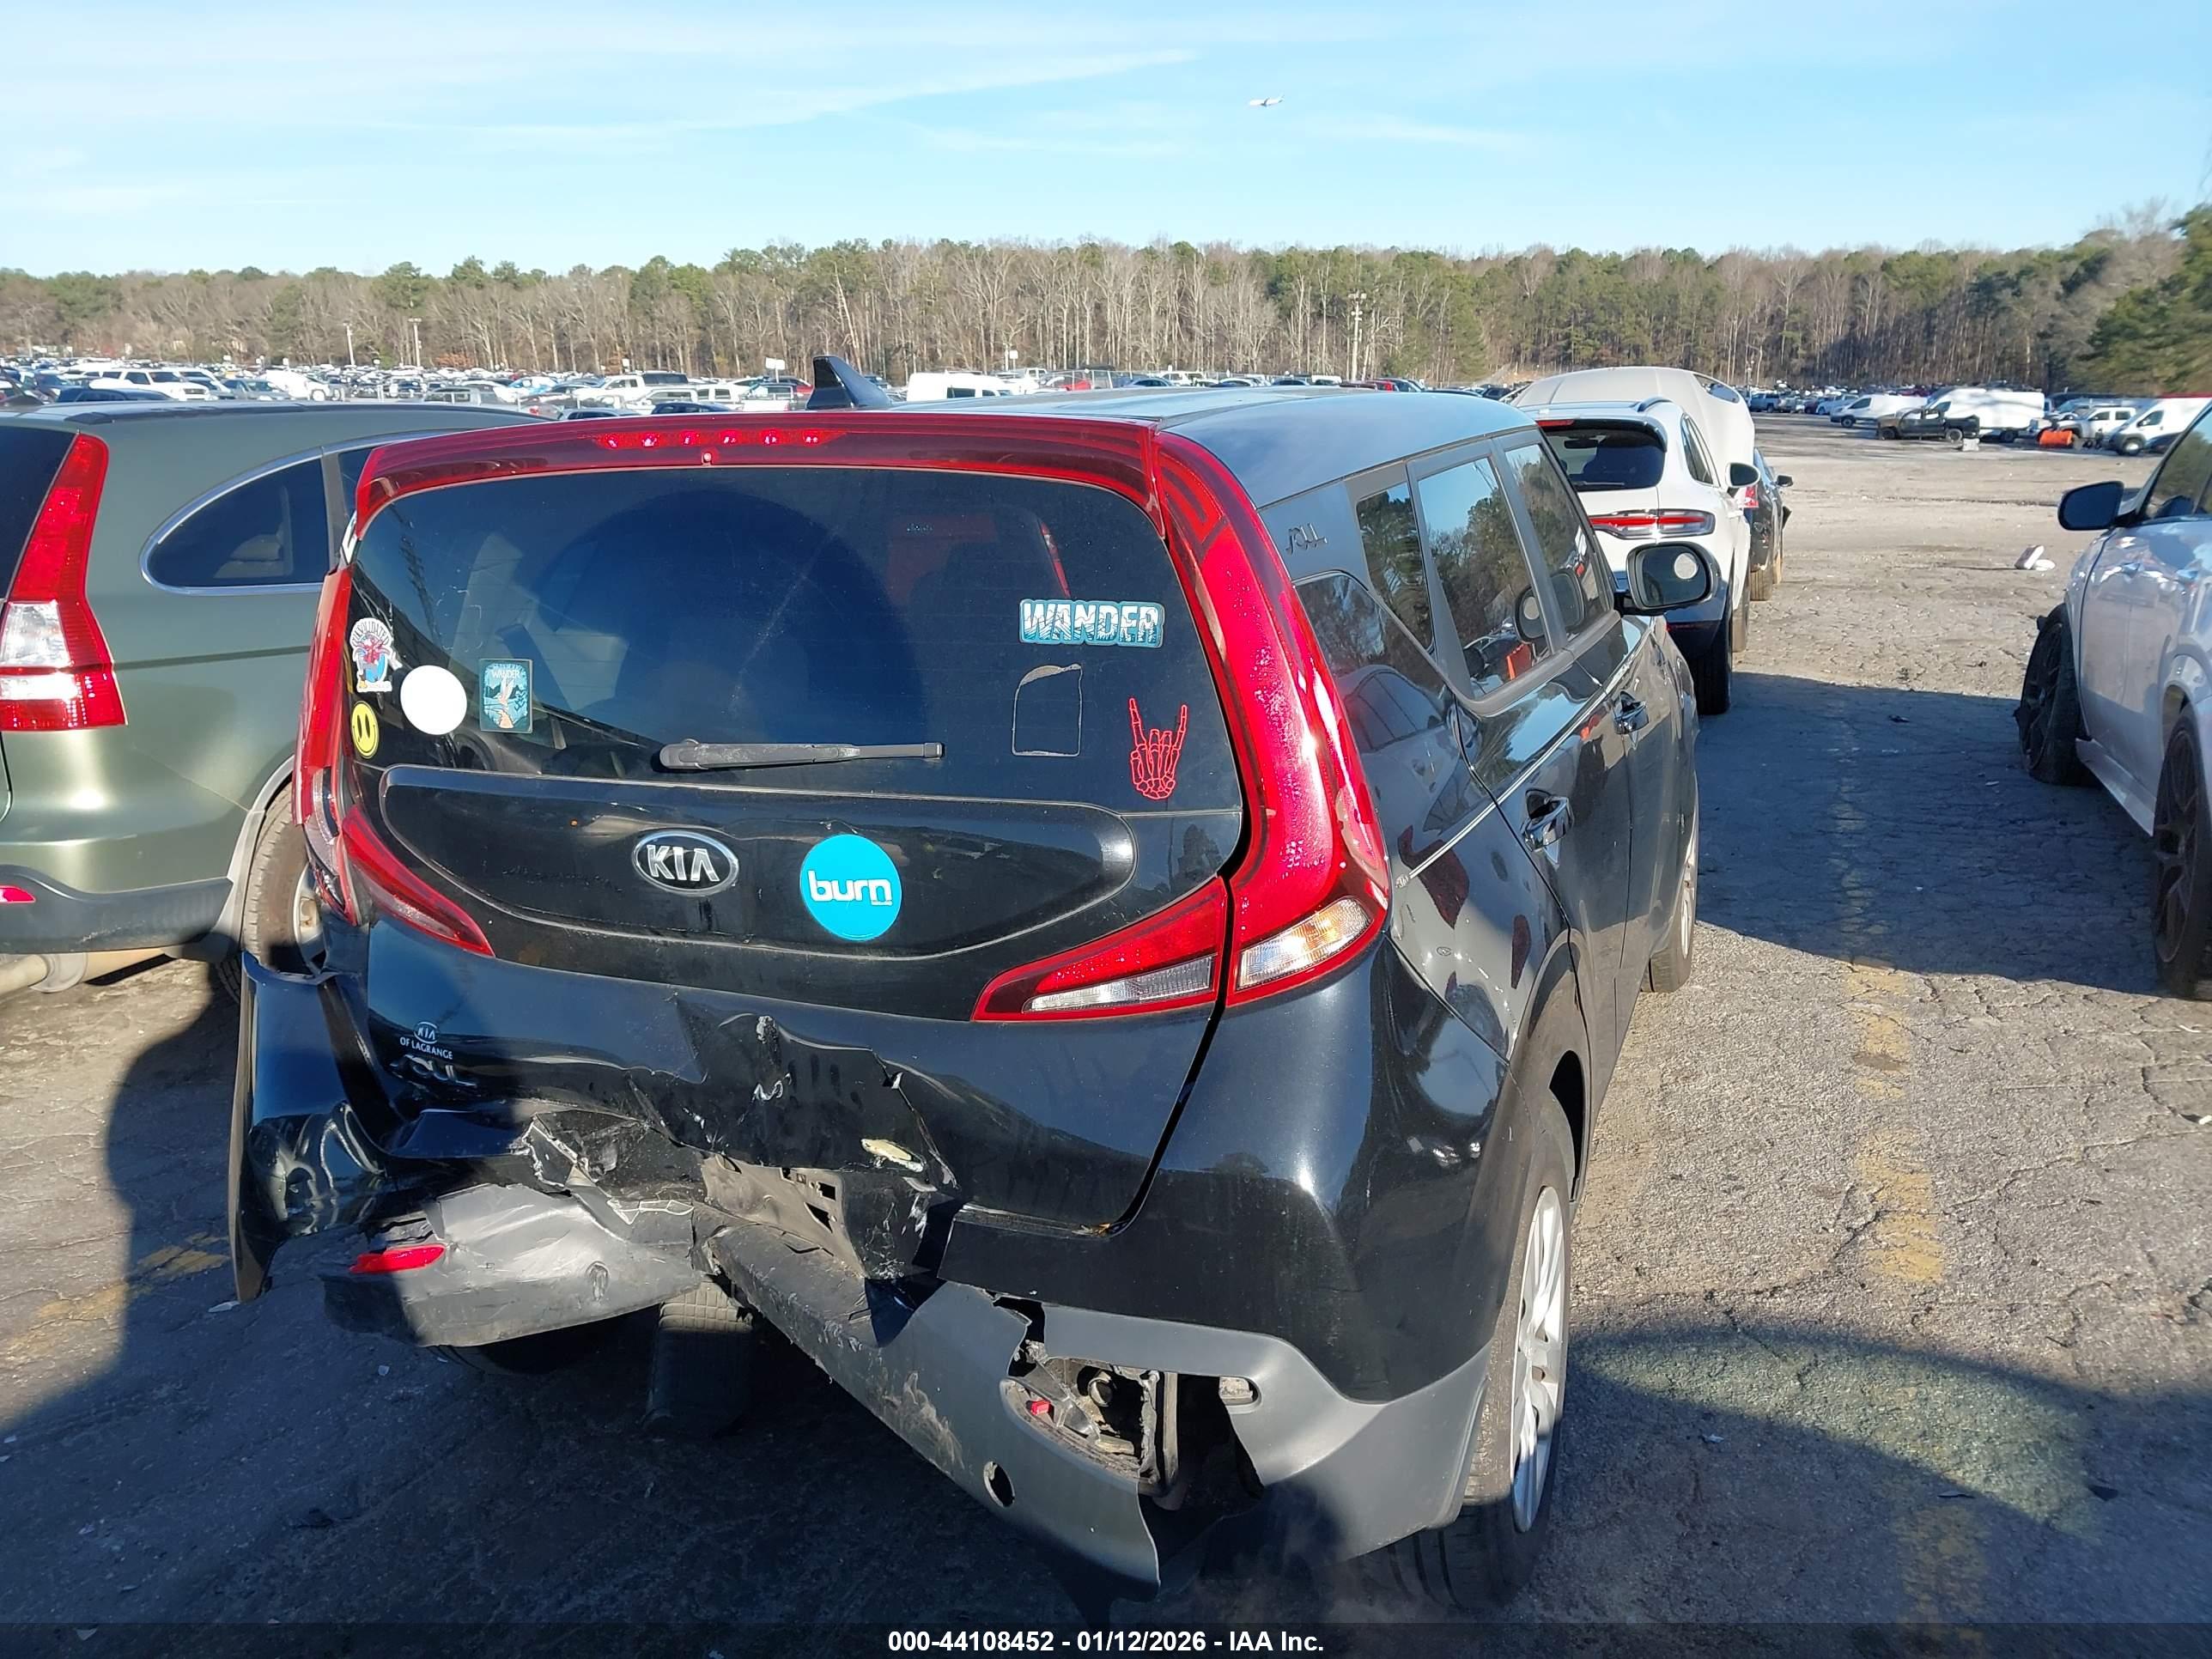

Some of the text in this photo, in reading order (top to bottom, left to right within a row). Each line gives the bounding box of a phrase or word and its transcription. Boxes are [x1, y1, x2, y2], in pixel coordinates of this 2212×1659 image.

[1023, 602, 1160, 643] WANDER
[646, 844, 720, 882] KIA
[807, 870, 892, 906] burn
[399, 1036, 453, 1060] OF LAGRANGE
[417, 1027, 435, 1040] KIA
